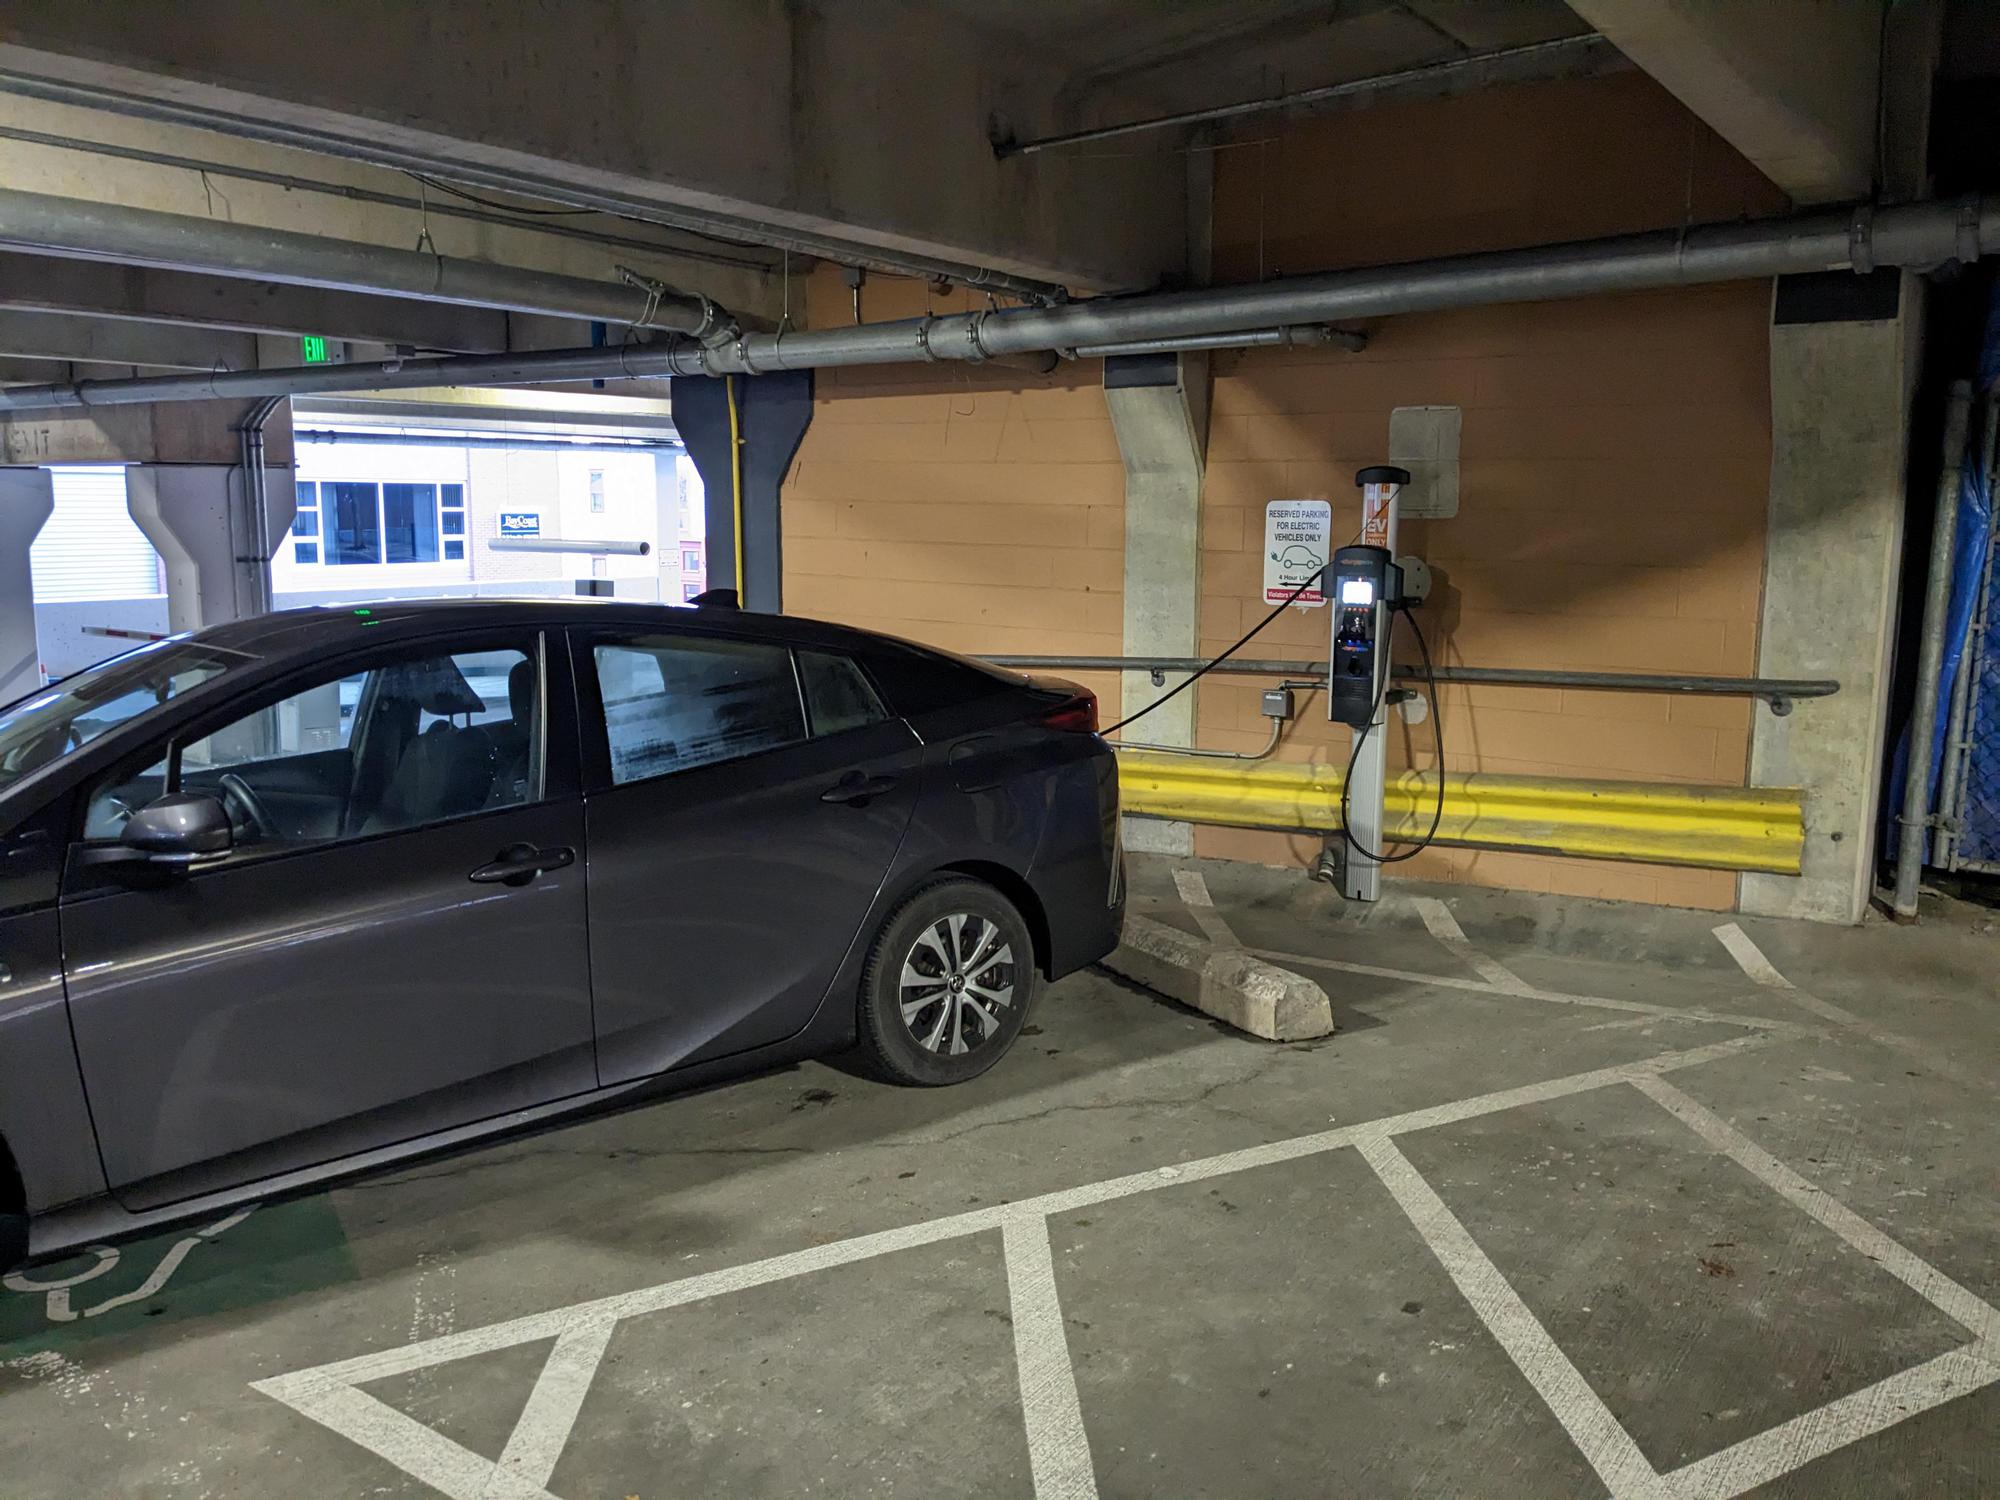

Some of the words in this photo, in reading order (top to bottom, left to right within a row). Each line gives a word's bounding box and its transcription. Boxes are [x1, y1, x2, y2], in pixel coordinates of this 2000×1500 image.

[304, 336, 325, 362] EXIT
[1268, 510, 1300, 518] RESERVED
[1302, 510, 1329, 518] PARKING
[1276, 521, 1289, 530] FOR
[1290, 522, 1320, 530] ELECTRIC
[1366, 519, 1387, 532] EV
[1274, 533, 1304, 541] VEHICLES
[1305, 534, 1322, 542] ONLY
[1365, 537, 1385, 547] ONLY
